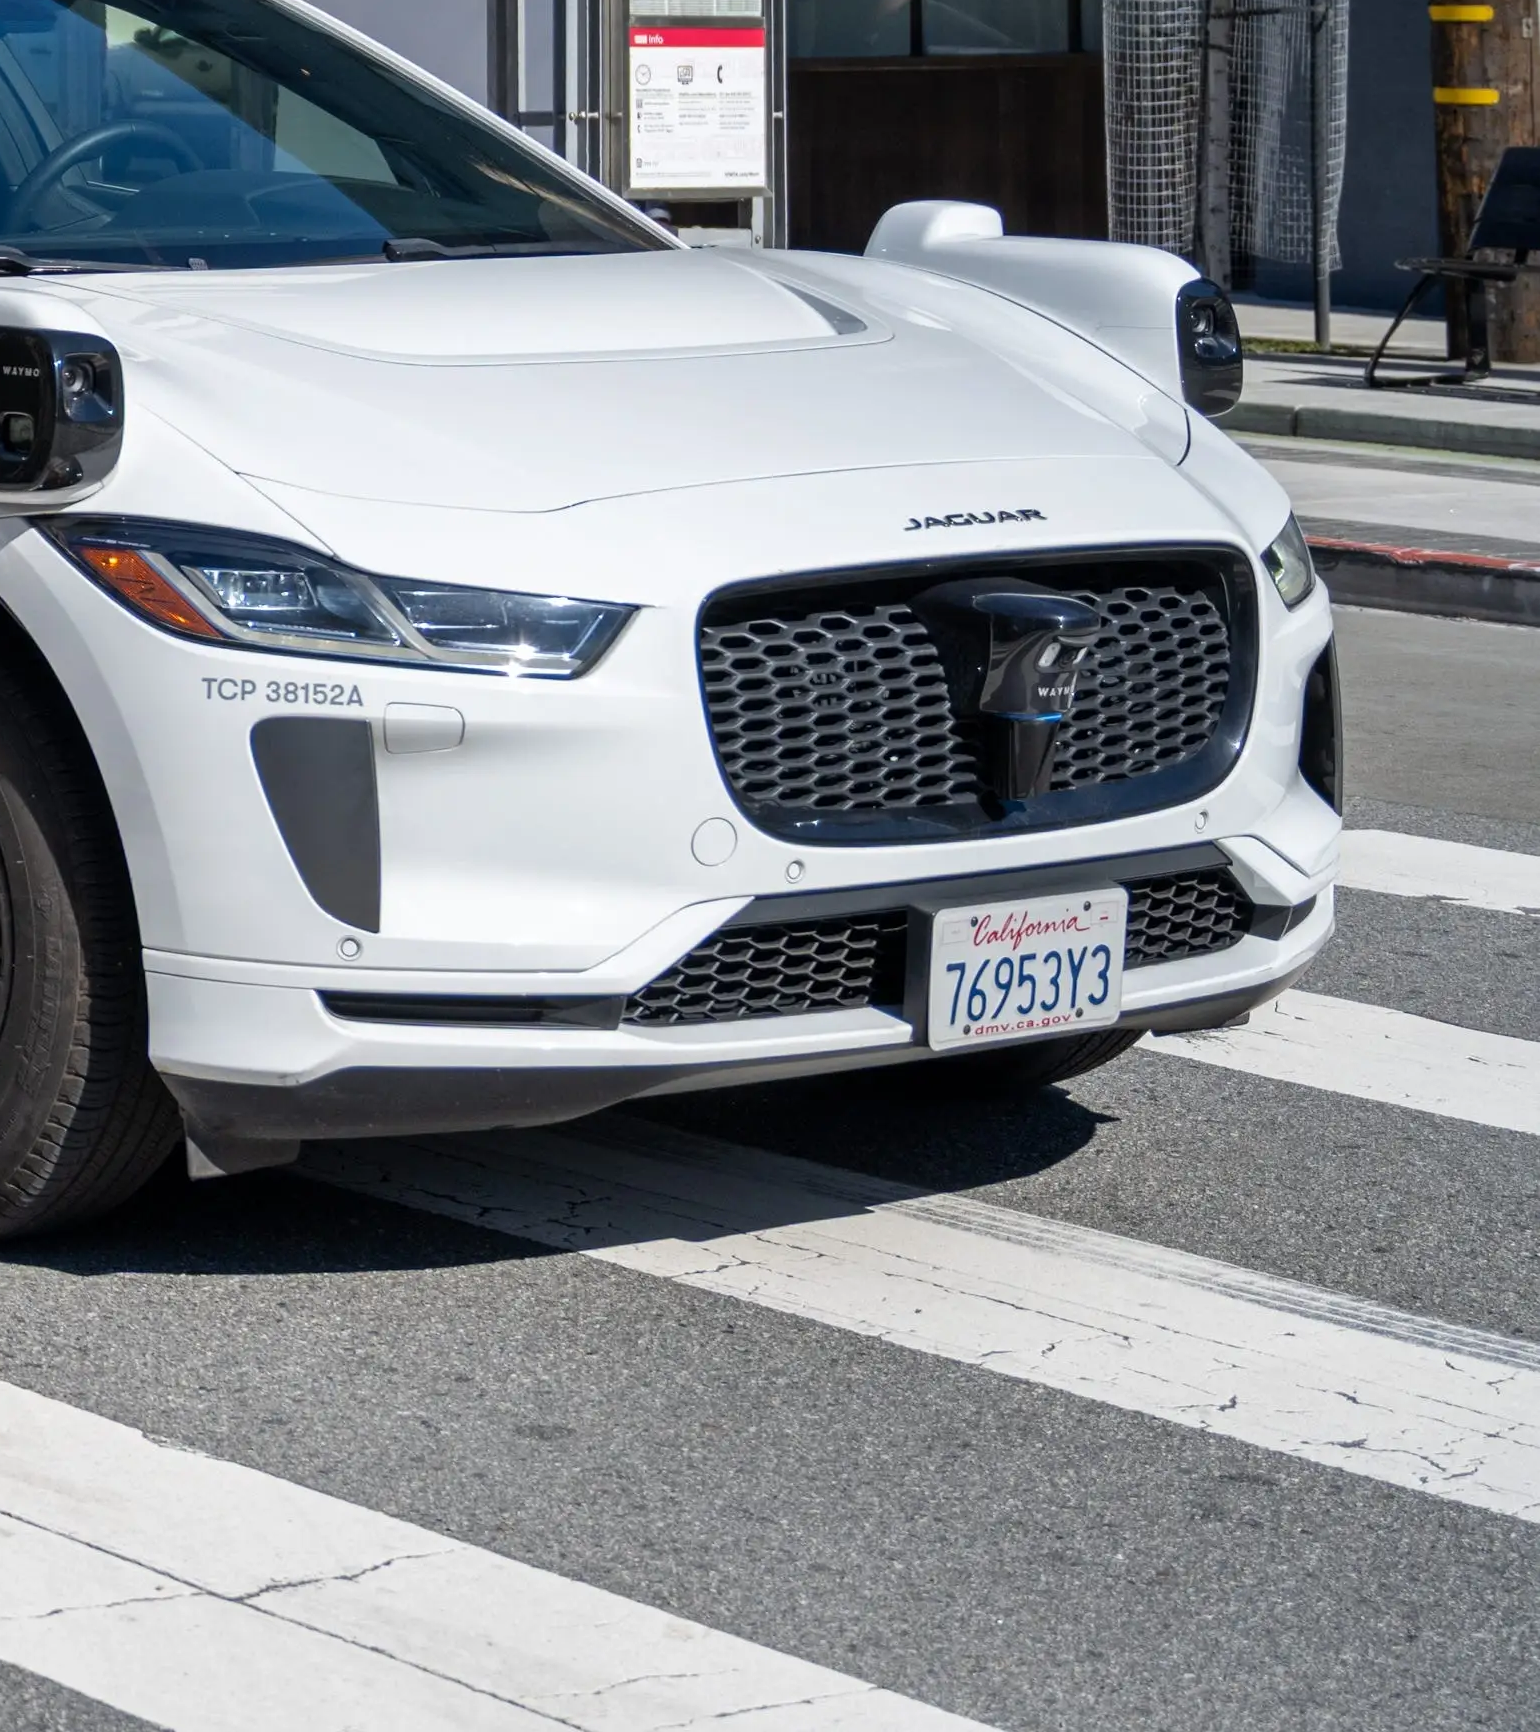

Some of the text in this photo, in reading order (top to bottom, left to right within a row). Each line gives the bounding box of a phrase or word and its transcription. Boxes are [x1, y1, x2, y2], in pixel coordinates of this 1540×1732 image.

[648, 33, 664, 44] Info
[2, 366, 40, 377] WAYMO
[903, 508, 1048, 532] JAGUAR
[201, 677, 364, 707] TCP 38152A
[973, 908, 1090, 951] California
[946, 943, 1111, 1026] 76953Y3
[975, 1013, 1072, 1036] dmv.ca.gov
